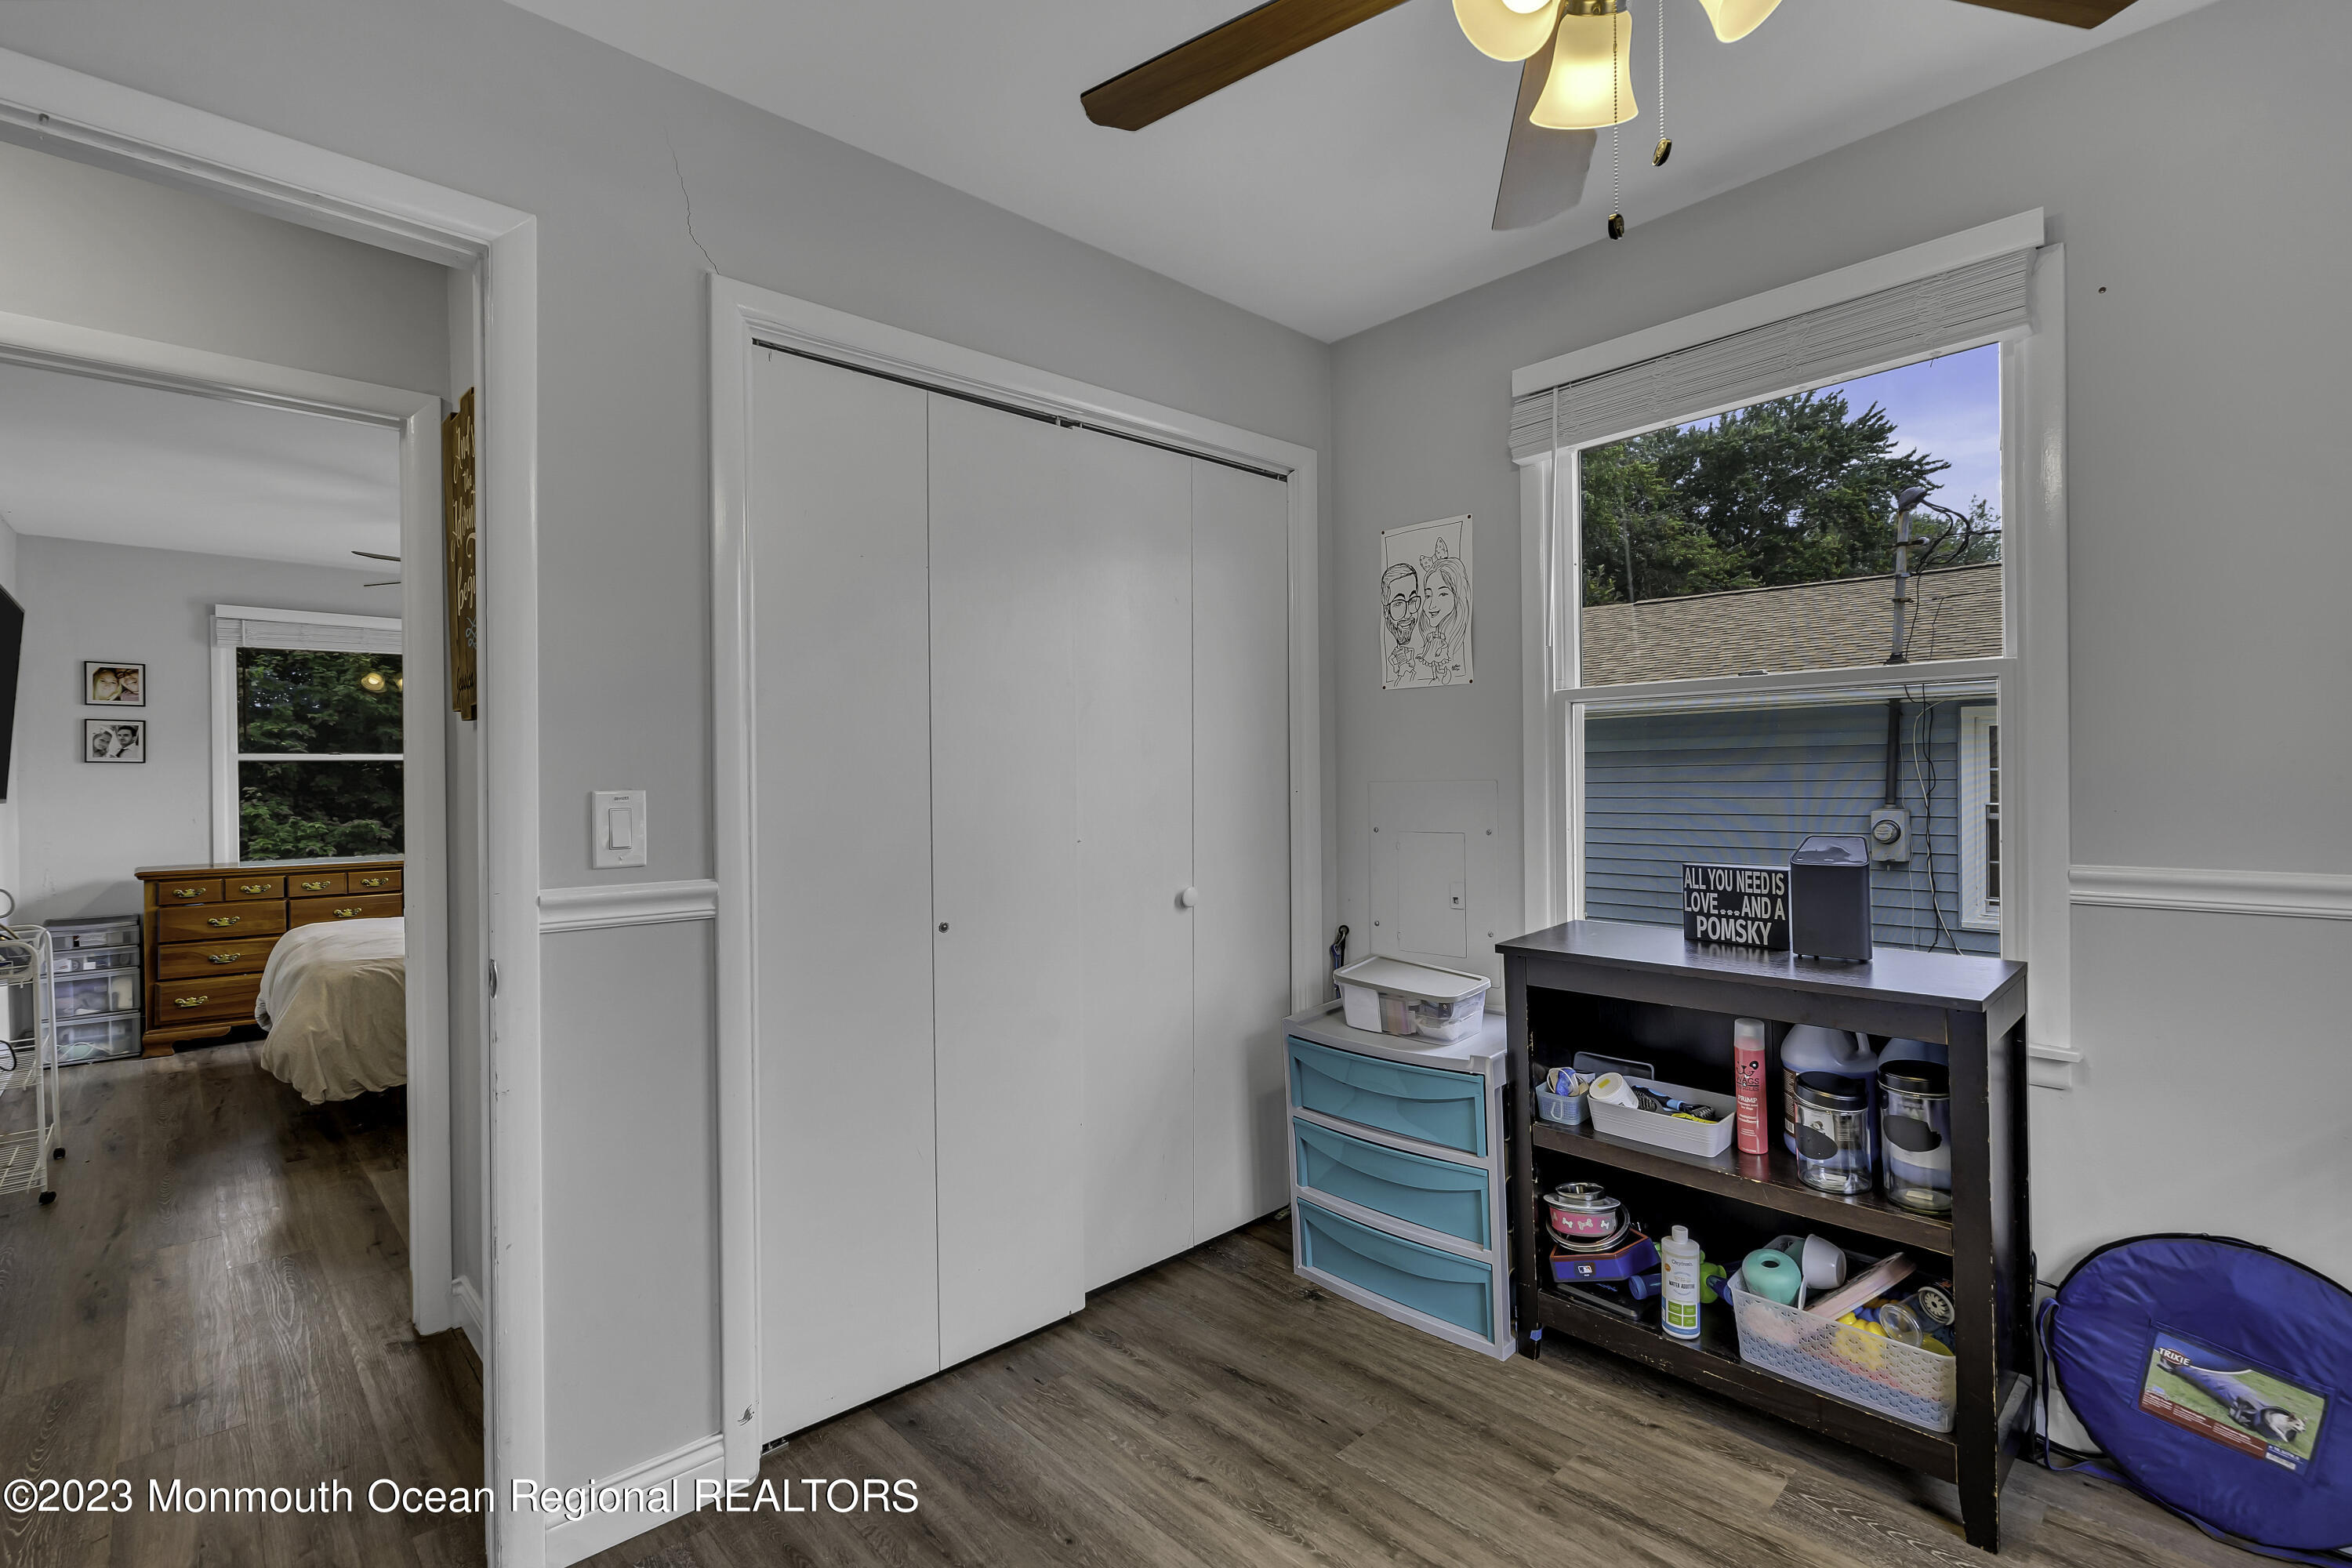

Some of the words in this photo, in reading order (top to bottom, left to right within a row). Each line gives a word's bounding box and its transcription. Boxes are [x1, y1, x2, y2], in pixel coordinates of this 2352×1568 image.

[462, 468, 472, 492] the
[451, 484, 476, 562] Advent
[457, 566, 476, 616] begi
[1684, 867, 1706, 889] ALL
[1708, 868, 1733, 891] YOU
[1737, 870, 1769, 895] NEED
[1772, 873, 1785, 895] IS
[1774, 898, 1785, 920] A
[1697, 916, 1772, 946] POMSKY
[2158, 1347, 2190, 1366] TRIXIE
